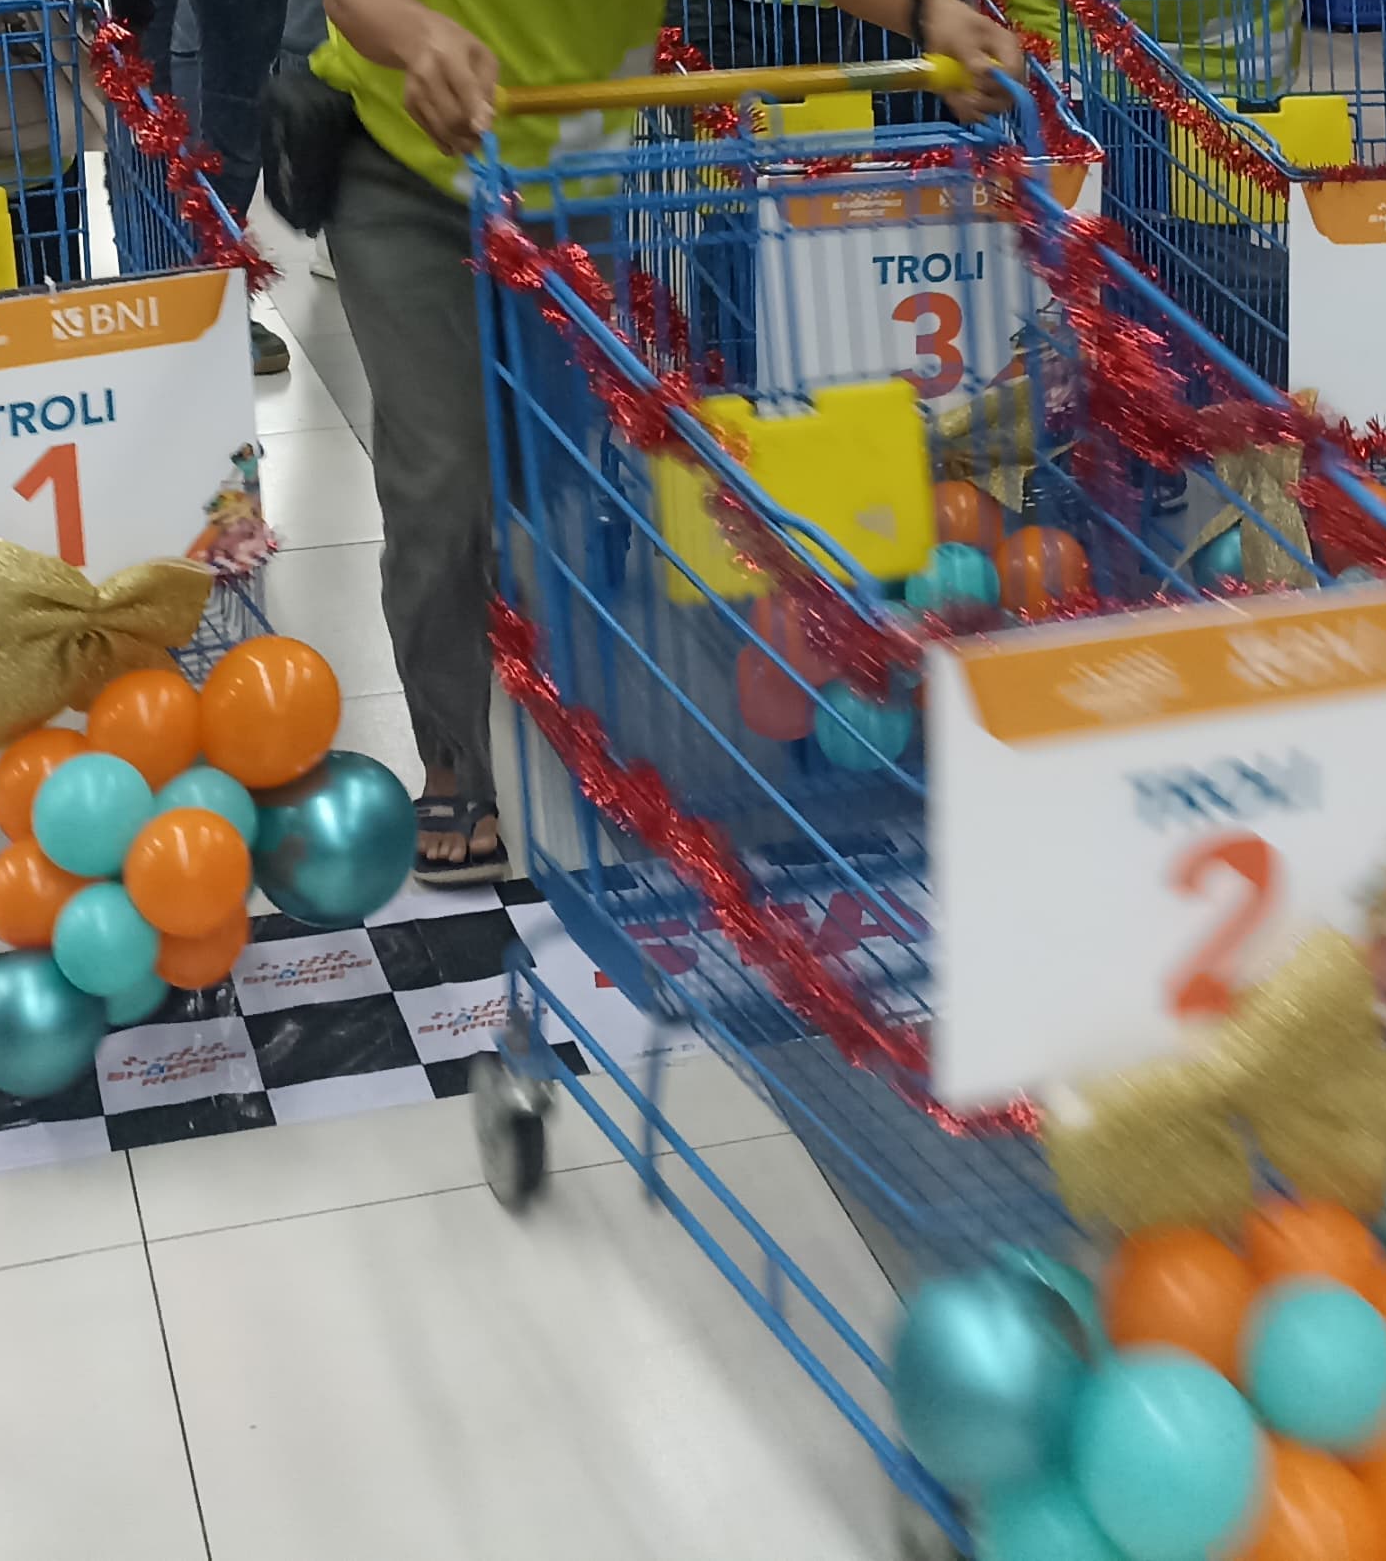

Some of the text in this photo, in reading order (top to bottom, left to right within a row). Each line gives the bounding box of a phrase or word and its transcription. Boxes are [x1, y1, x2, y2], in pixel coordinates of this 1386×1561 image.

[872, 250, 984, 286] TROLI
[89, 295, 160, 336] BNI
[891, 291, 965, 401] 3
[13, 442, 86, 567] 1
[1160, 830, 1290, 1021] 2
[242, 957, 374, 986] SHOPPING
[106, 1050, 248, 1083] SHOPPING
